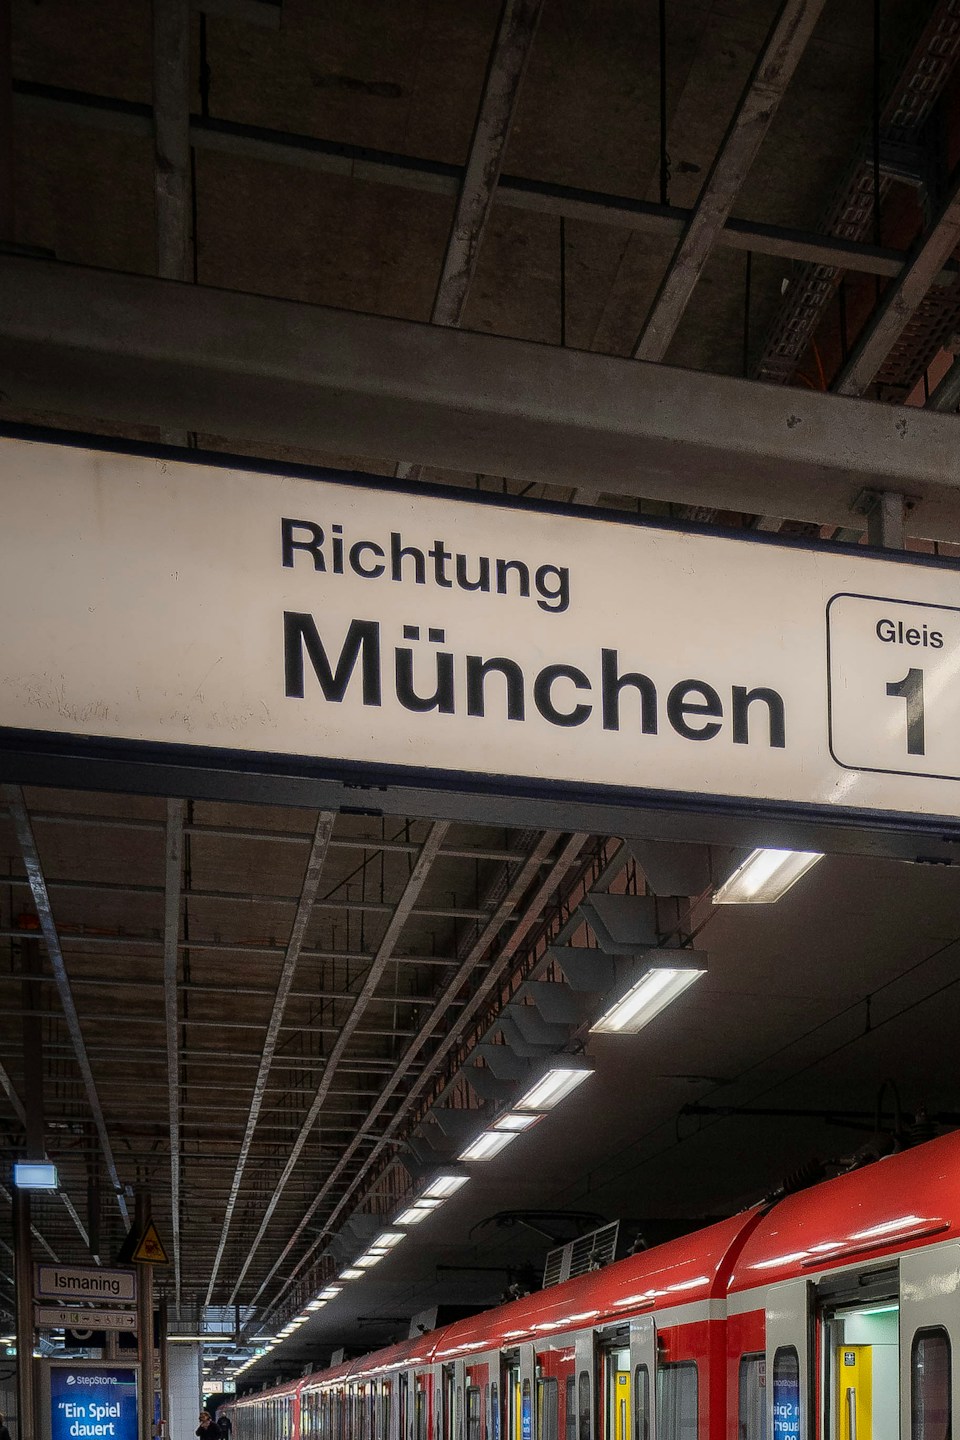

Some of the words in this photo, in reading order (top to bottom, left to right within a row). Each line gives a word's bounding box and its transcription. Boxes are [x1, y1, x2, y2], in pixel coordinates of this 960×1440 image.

[281, 517, 570, 613] Richtung
[875, 618, 944, 649] Gleis
[283, 610, 786, 749] München
[885, 667, 925, 756] 1
[54, 1272, 120, 1295] Ismaning
[76, 1376, 118, 1386] StepStone
[89, 1402, 121, 1421] Spiel
[70, 1421, 115, 1436] dauert
